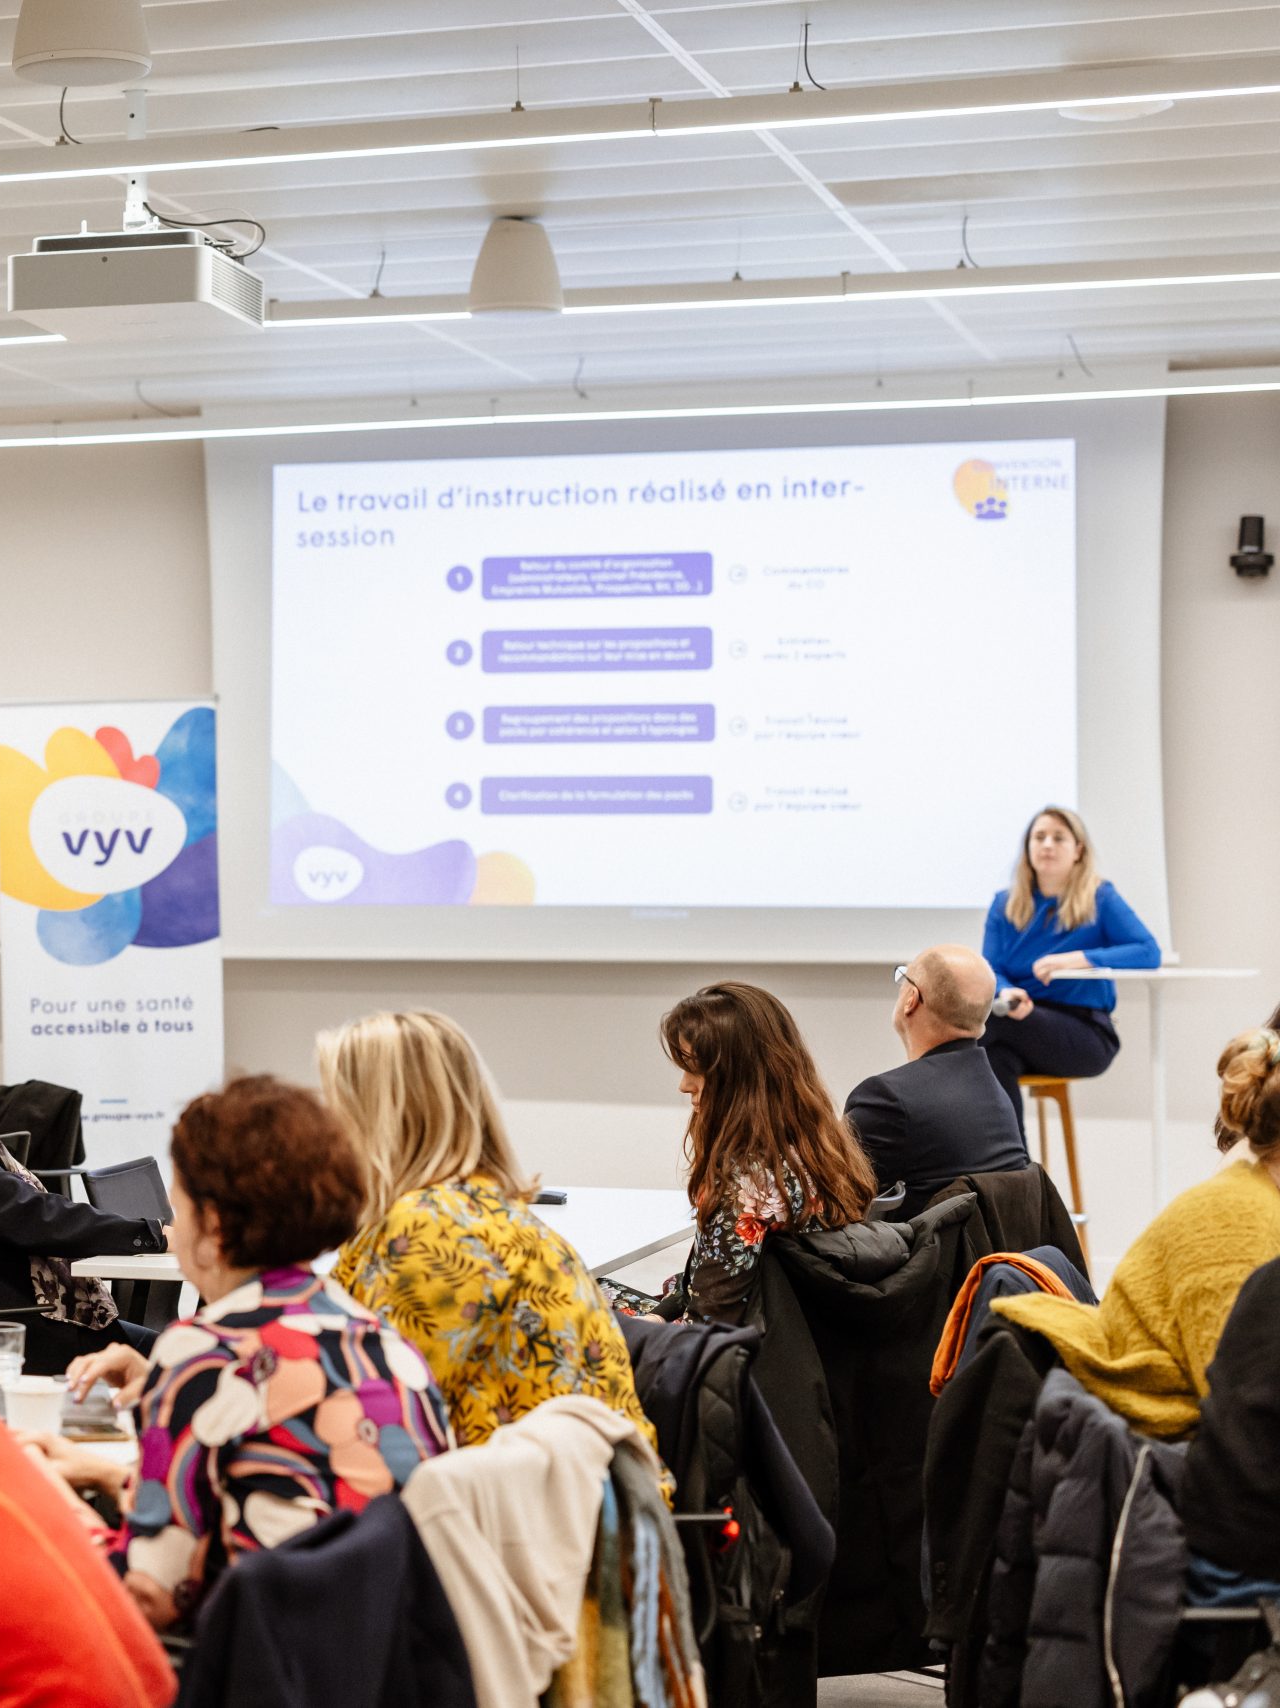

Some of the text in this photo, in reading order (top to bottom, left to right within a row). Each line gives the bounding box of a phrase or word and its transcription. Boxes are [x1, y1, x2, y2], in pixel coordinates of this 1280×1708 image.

[297, 476, 866, 513] Le travail d'instruction réalisé en inter-
[296, 524, 396, 549] session
[61, 826, 153, 867] vyv
[307, 869, 349, 889] vyv
[30, 995, 194, 1014] Pour une santé
[31, 1018, 194, 1036] accessible à tous
